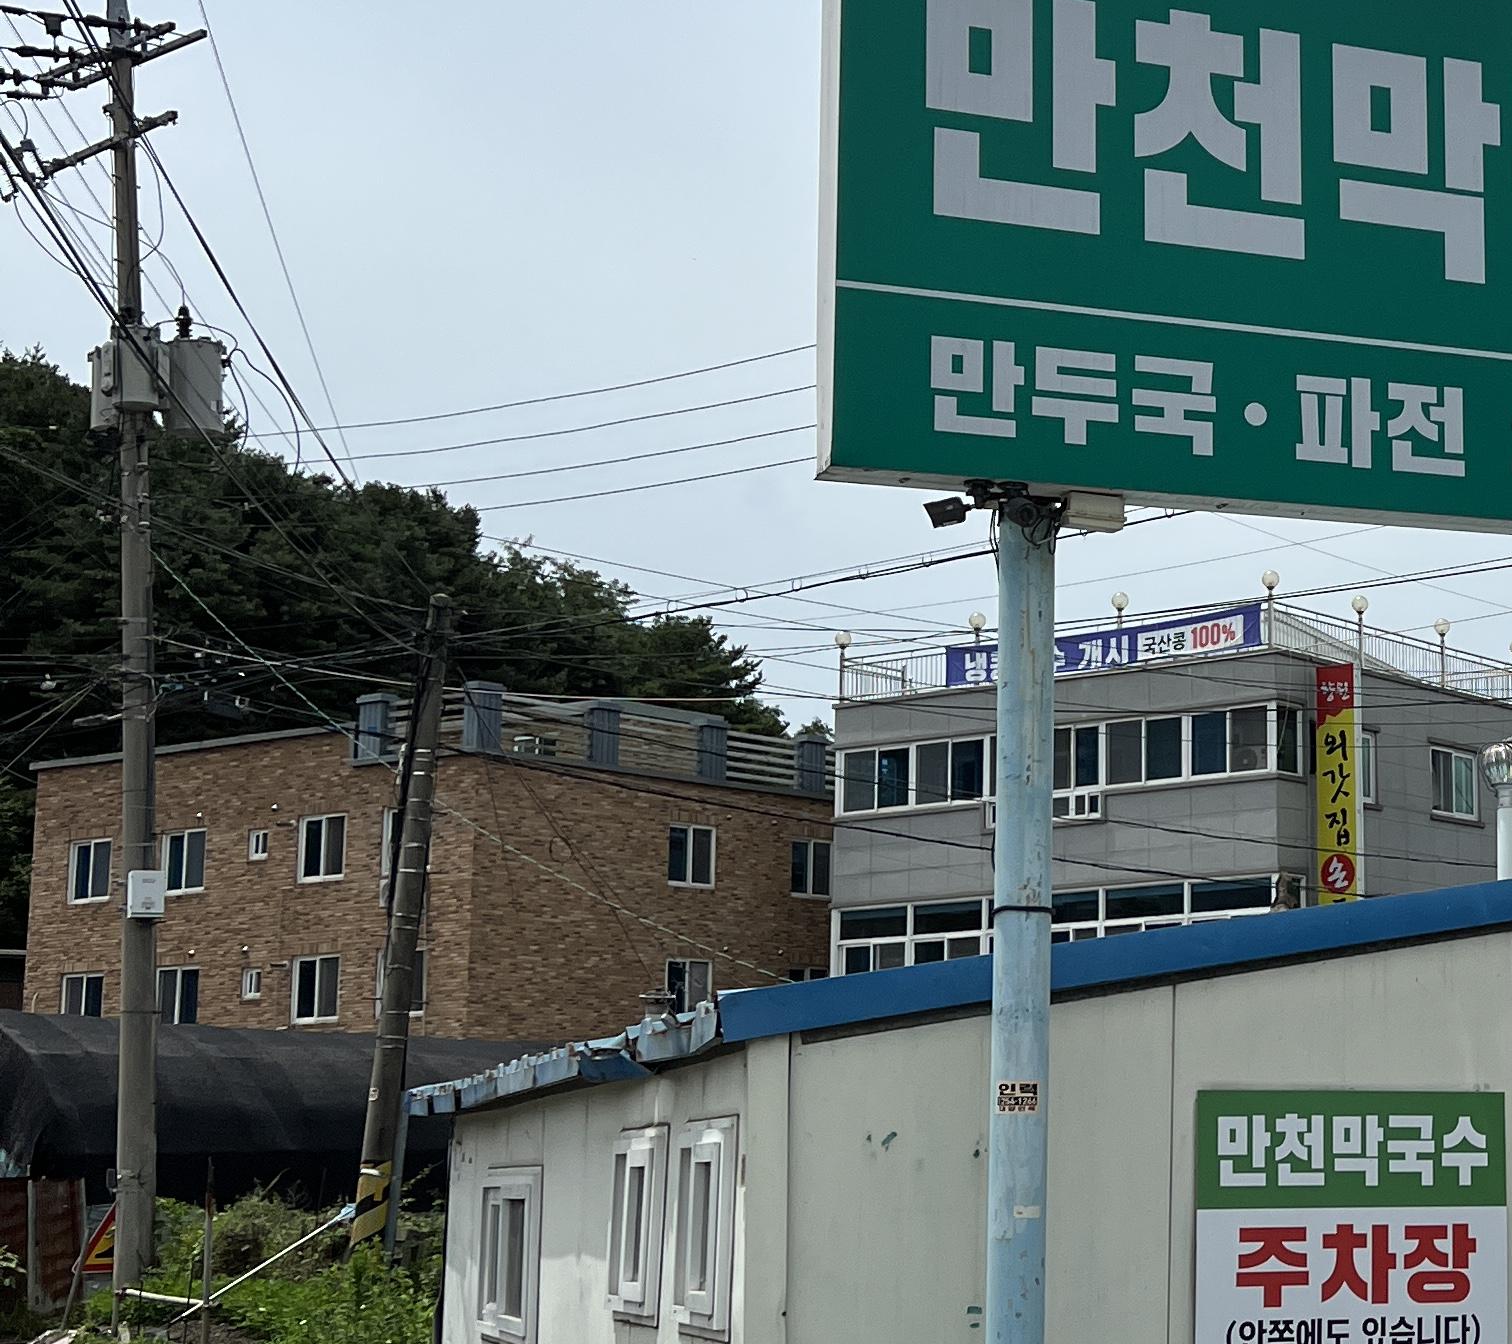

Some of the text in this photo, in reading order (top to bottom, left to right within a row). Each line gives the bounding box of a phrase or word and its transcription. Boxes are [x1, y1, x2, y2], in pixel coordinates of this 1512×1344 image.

[930, 334, 1215, 457] 만두국
[1296, 373, 1466, 478] 파전
[1190, 621, 1236, 650] 100%
[1217, 1113, 1488, 1187] 만천막국수
[1235, 1222, 1477, 1308] 주차장
